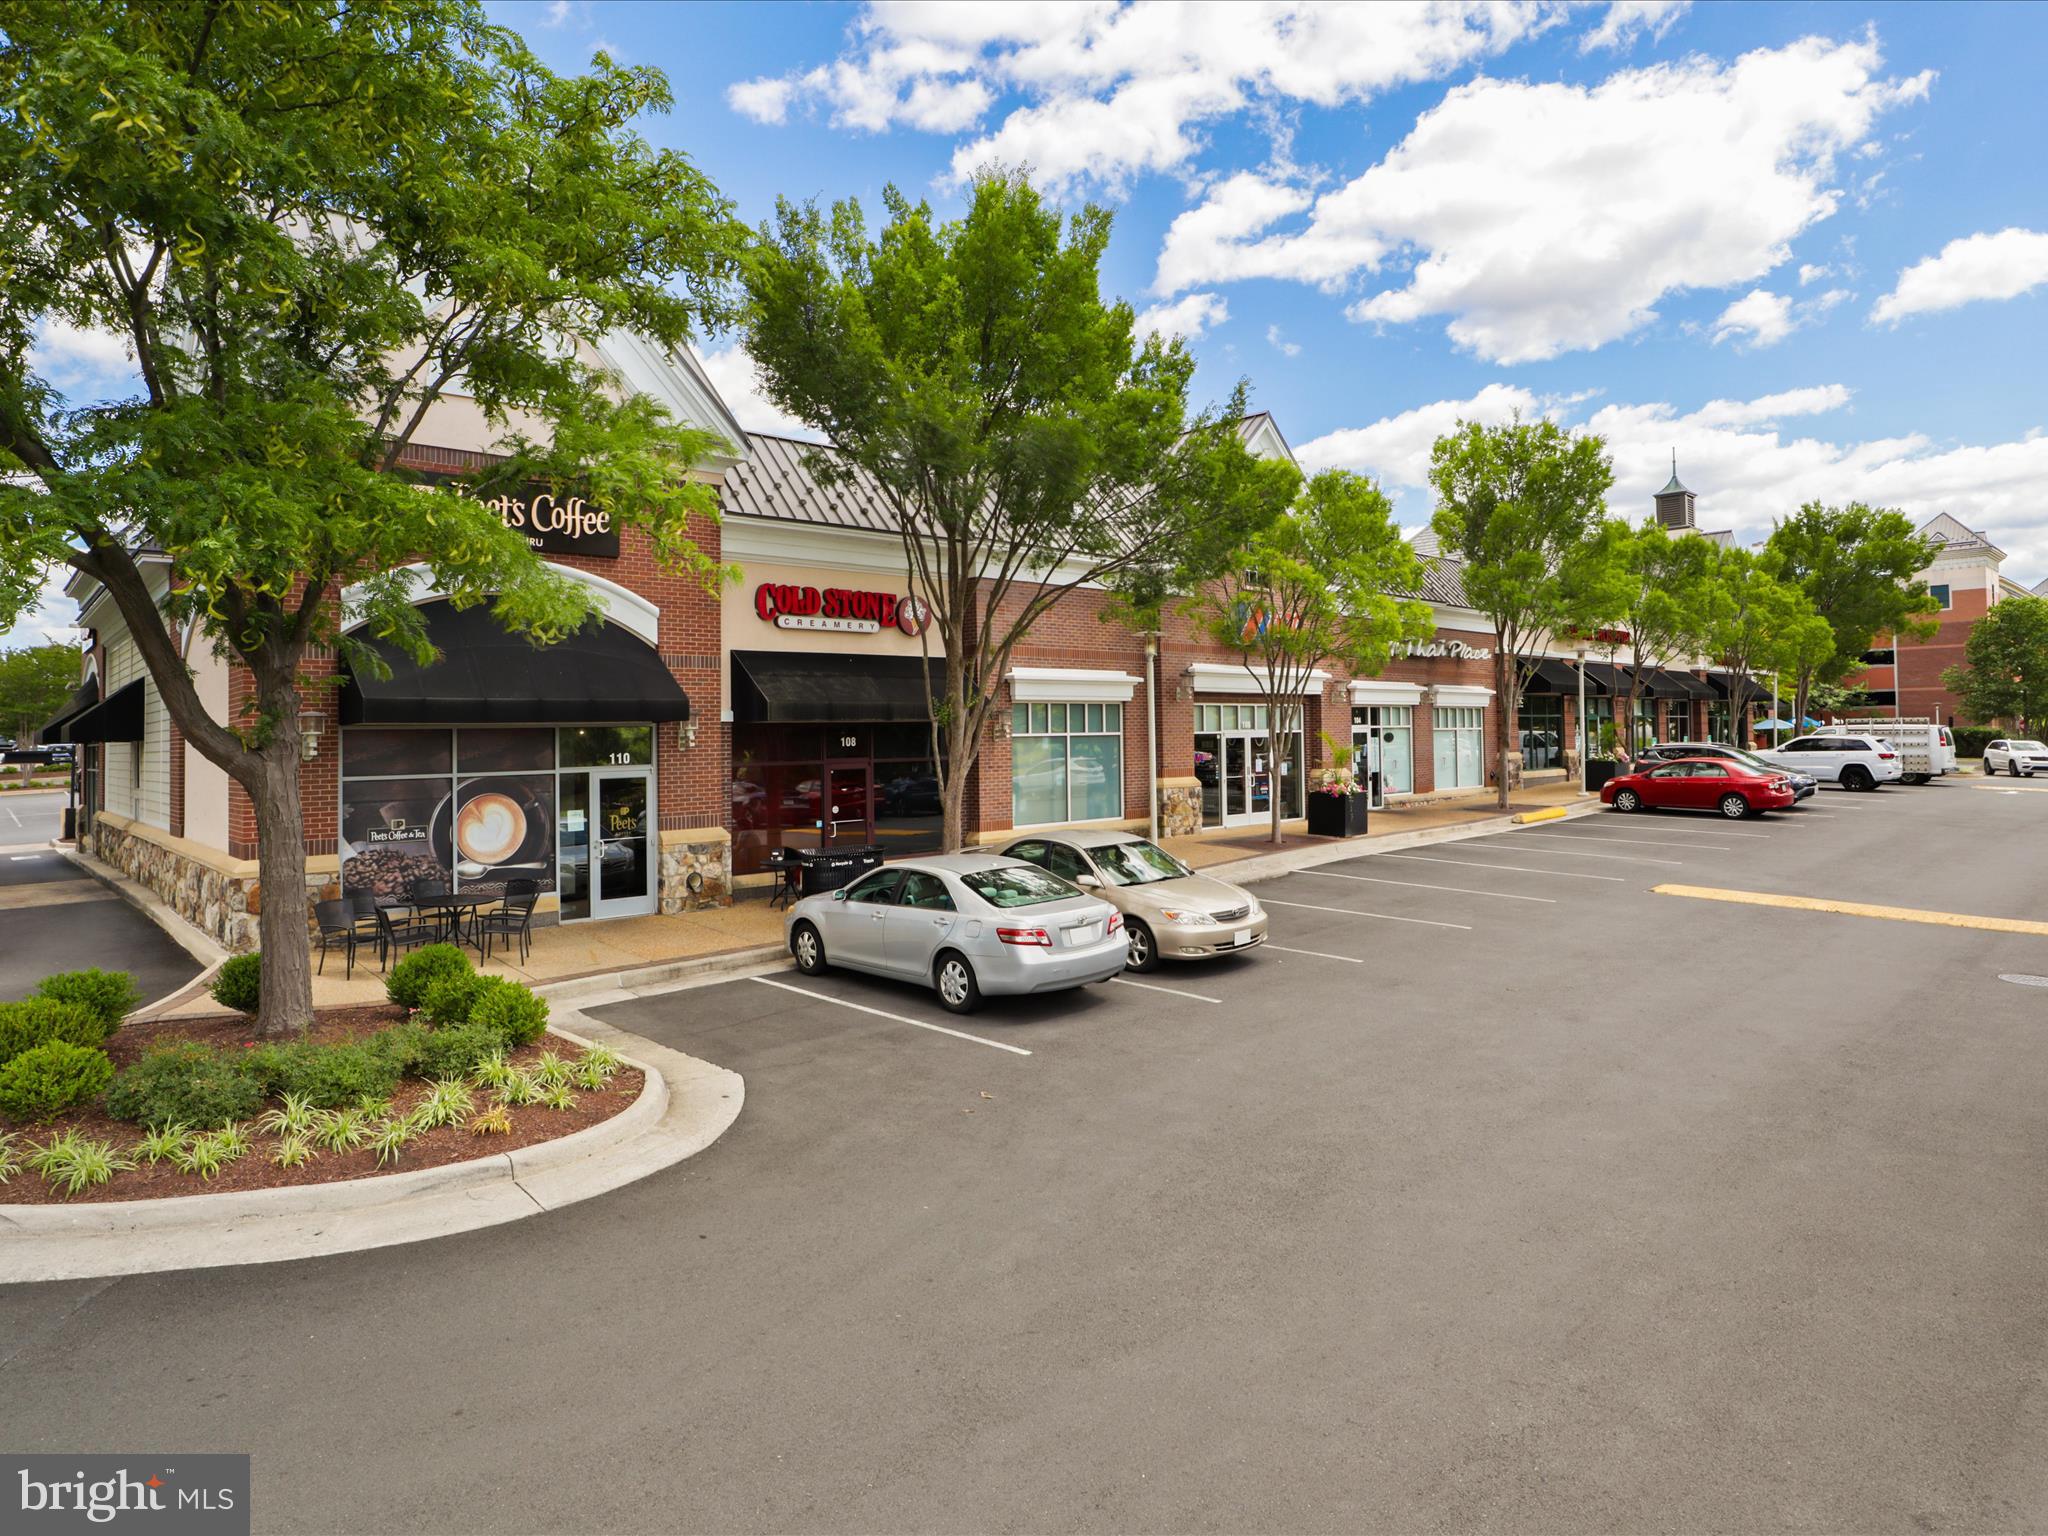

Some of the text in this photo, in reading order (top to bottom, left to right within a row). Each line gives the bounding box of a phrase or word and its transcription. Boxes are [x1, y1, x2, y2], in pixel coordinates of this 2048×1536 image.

[531, 494, 610, 539] Coffee
[756, 583, 897, 627] COLD STONE
[784, 617, 876, 630] CREAMERY
[1448, 641, 1492, 660] Place
[840, 737, 857, 747] 108
[609, 752, 630, 765] 110
[388, 830, 408, 841] Coffee
[413, 829, 426, 839] Tea
